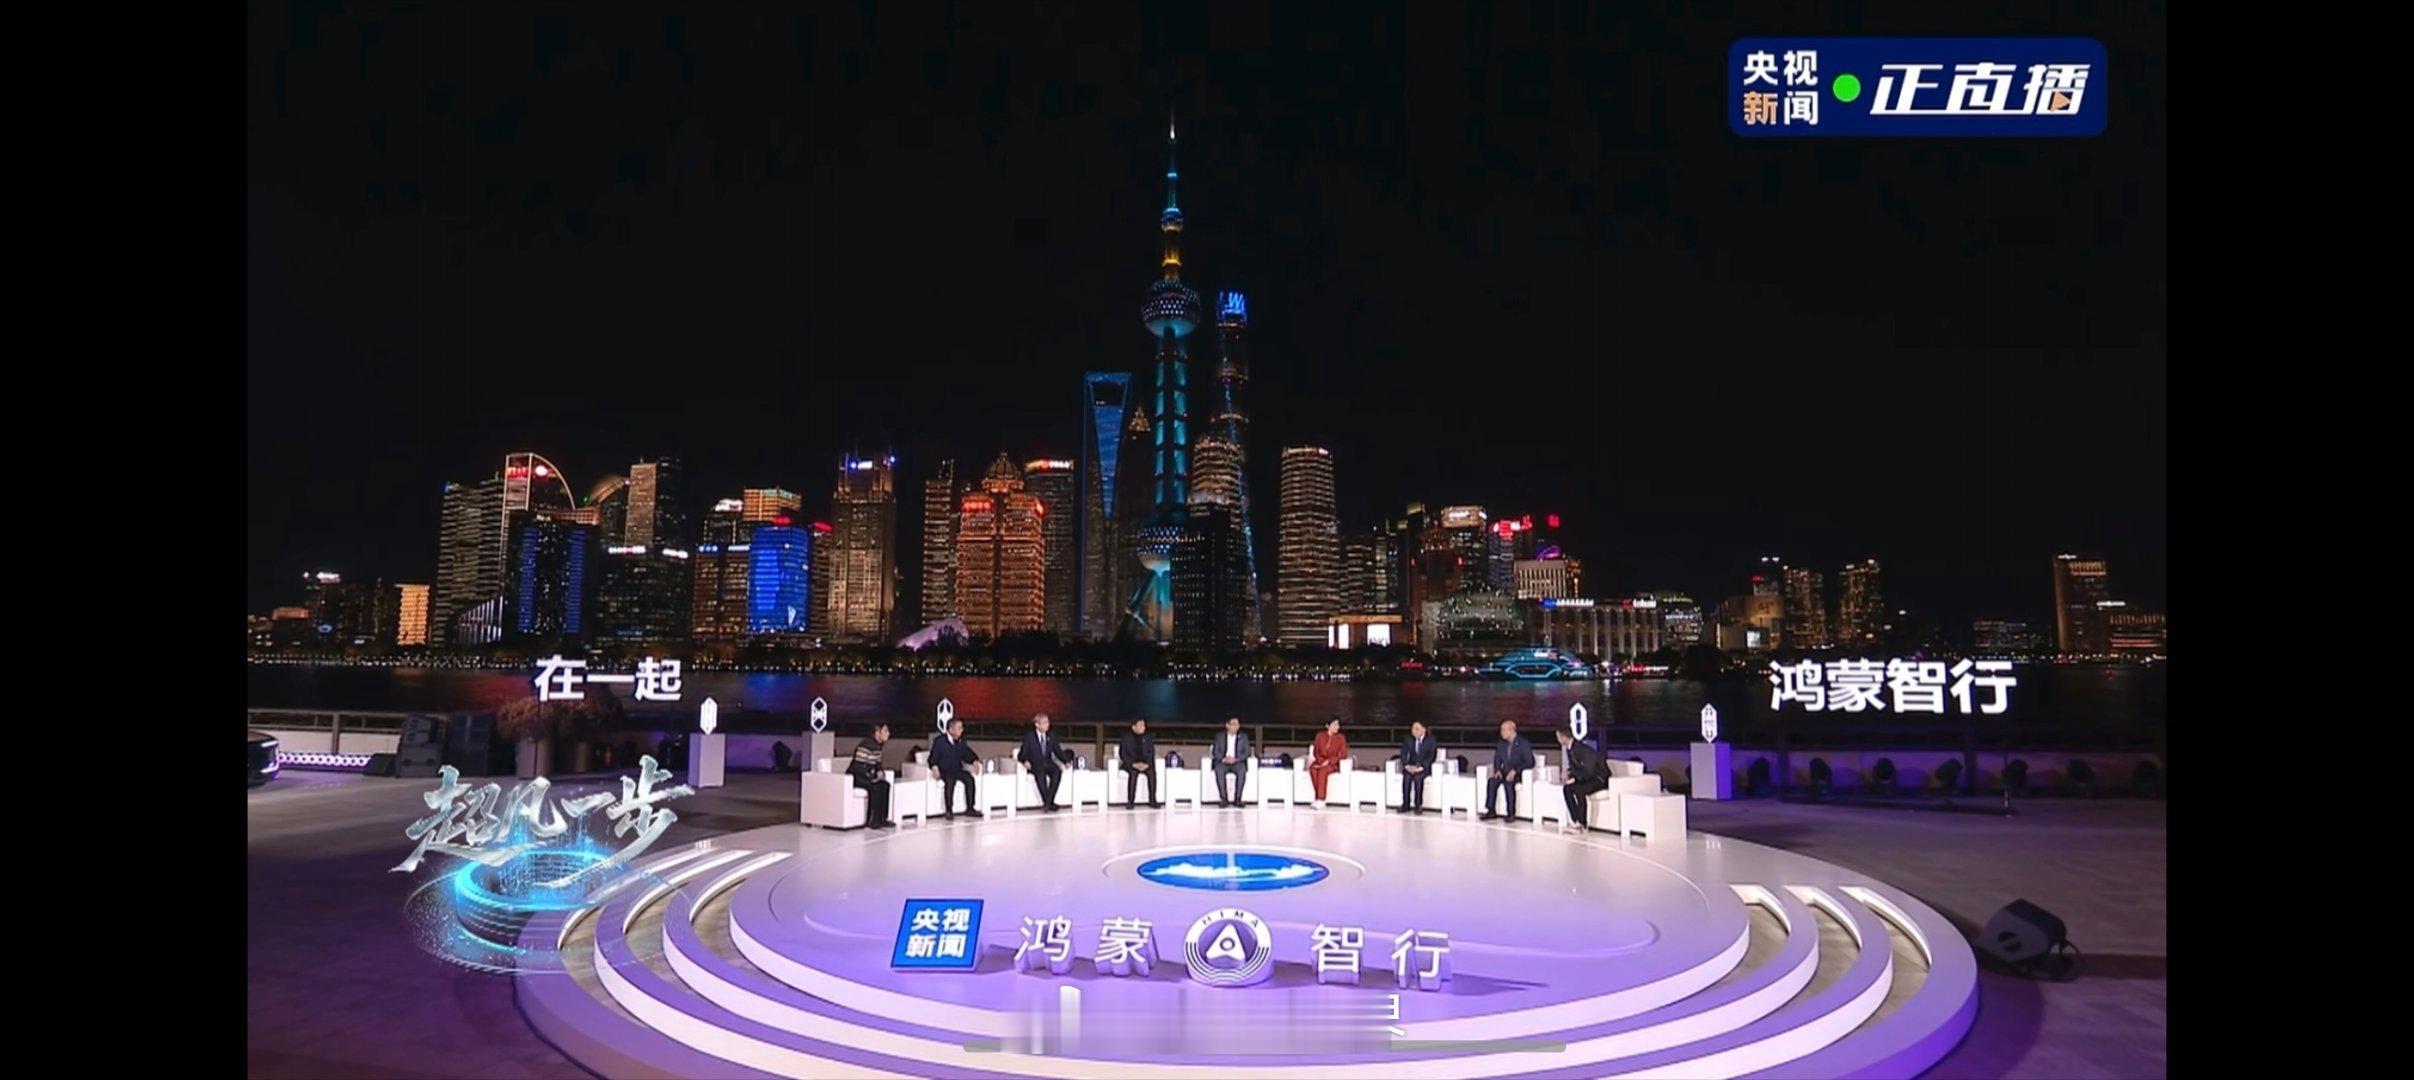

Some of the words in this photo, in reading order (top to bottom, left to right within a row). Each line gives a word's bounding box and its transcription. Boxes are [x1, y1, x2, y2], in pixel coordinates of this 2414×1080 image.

[534, 654, 682, 702] 在一起
[1768, 657, 2017, 714] 鸿蒙智行
[911, 908, 971, 932] 央视
[1201, 910, 1259, 928] HIMA
[904, 933, 967, 958] 新闻
[1014, 914, 1152, 964] 鸿蒙
[1309, 923, 1451, 980] 智行
